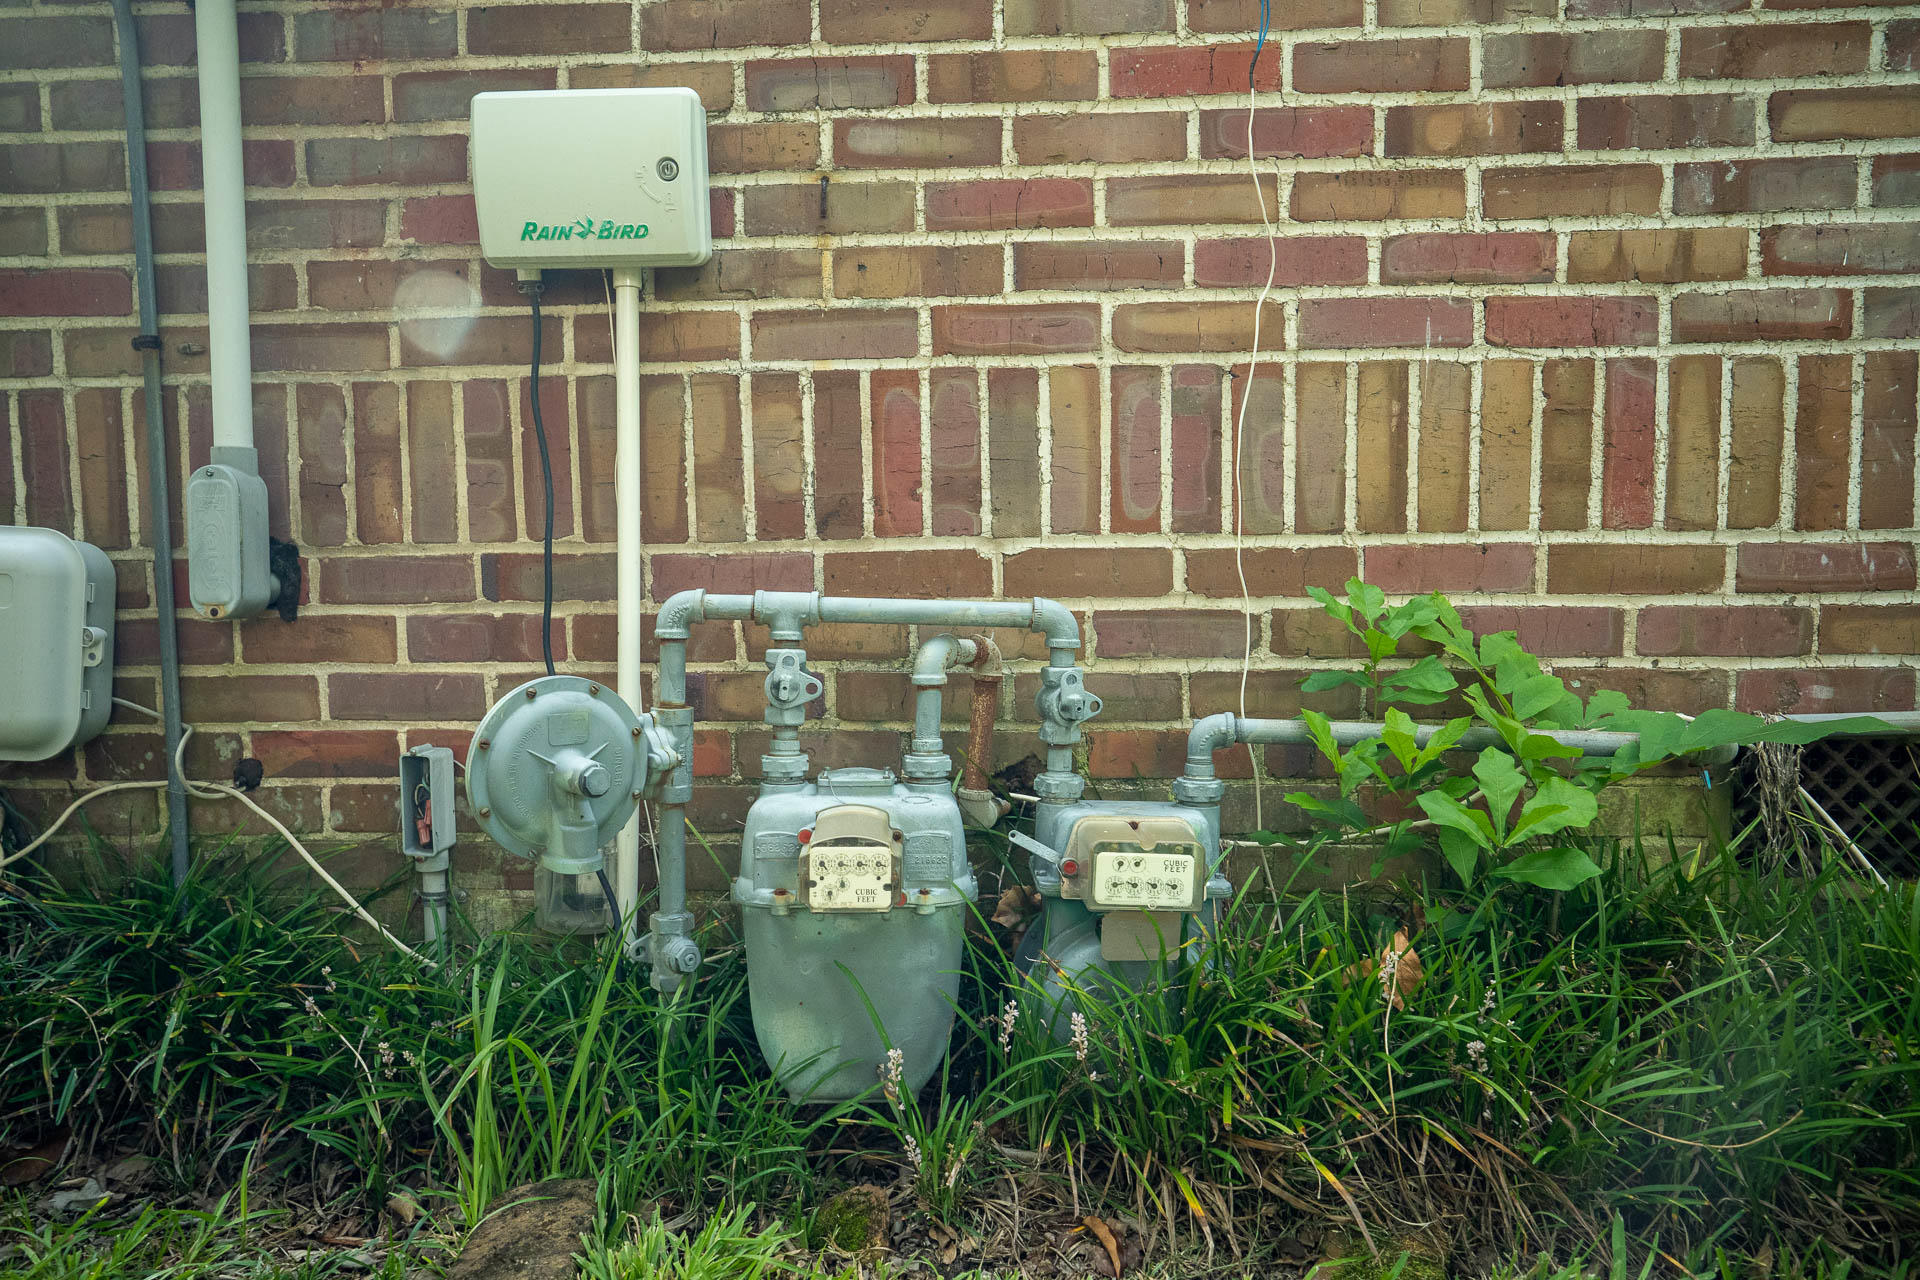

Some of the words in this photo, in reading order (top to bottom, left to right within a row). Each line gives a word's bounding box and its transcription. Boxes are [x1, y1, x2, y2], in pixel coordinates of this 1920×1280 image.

[520, 221, 575, 241] RAIN
[597, 219, 649, 240] BIRD
[857, 895, 876, 903] FEET
